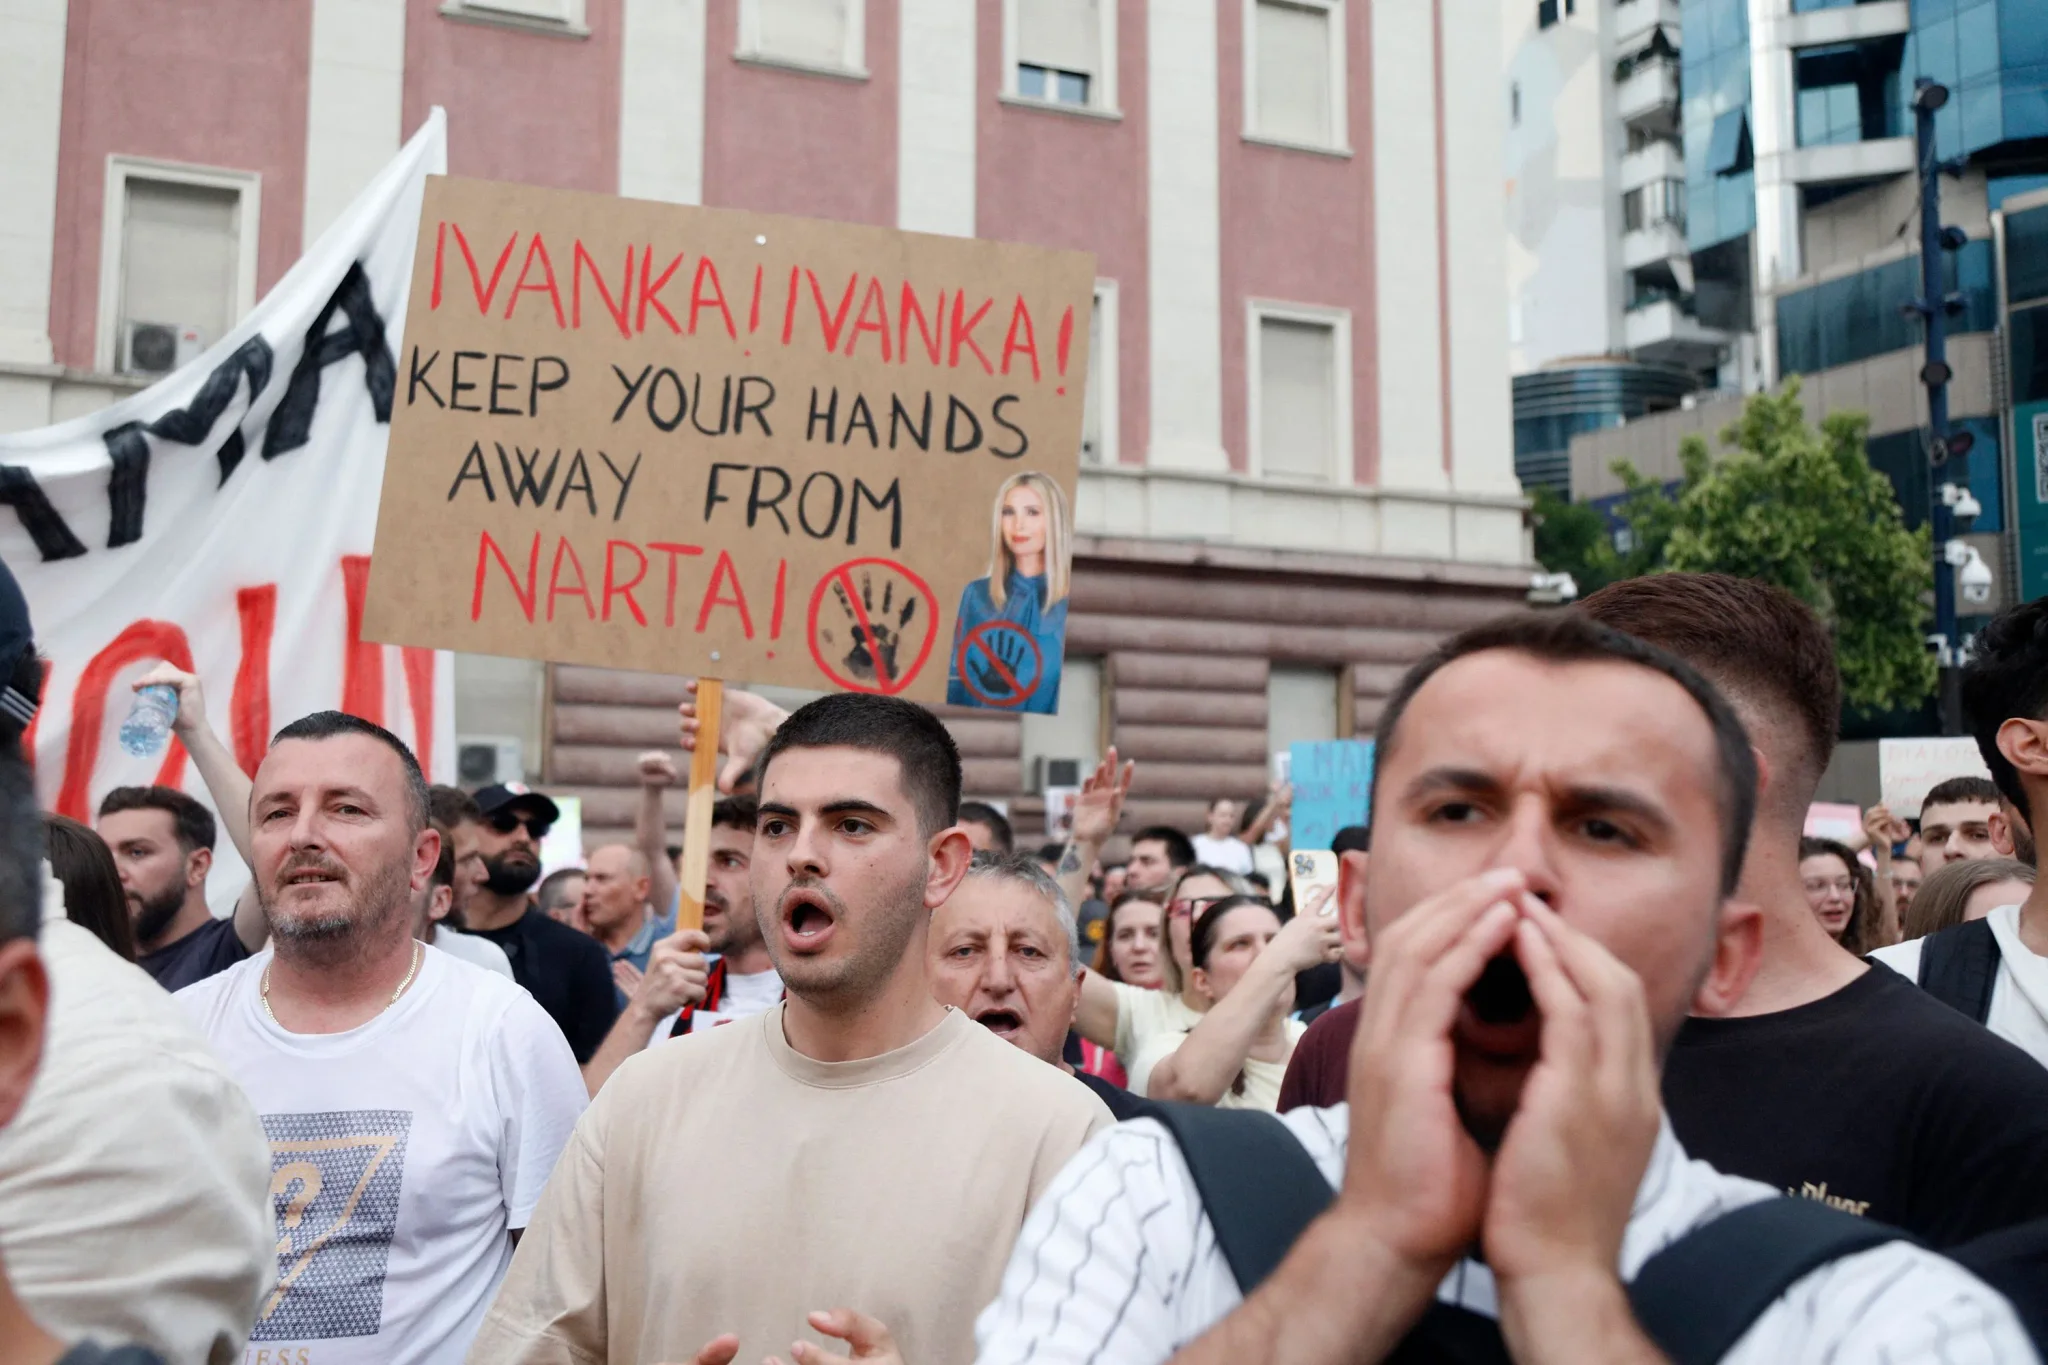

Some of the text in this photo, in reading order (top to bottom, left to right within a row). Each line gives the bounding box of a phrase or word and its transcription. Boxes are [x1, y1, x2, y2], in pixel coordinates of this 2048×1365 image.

[430, 221, 1074, 396] IVANKA! IVANKA!
[407, 345, 1029, 459] KEEP YOUR HANDS
[448, 442, 902, 550] AWAY FROM
[471, 530, 788, 659] NARTA!
[246, 1348, 311, 1365] ESS
